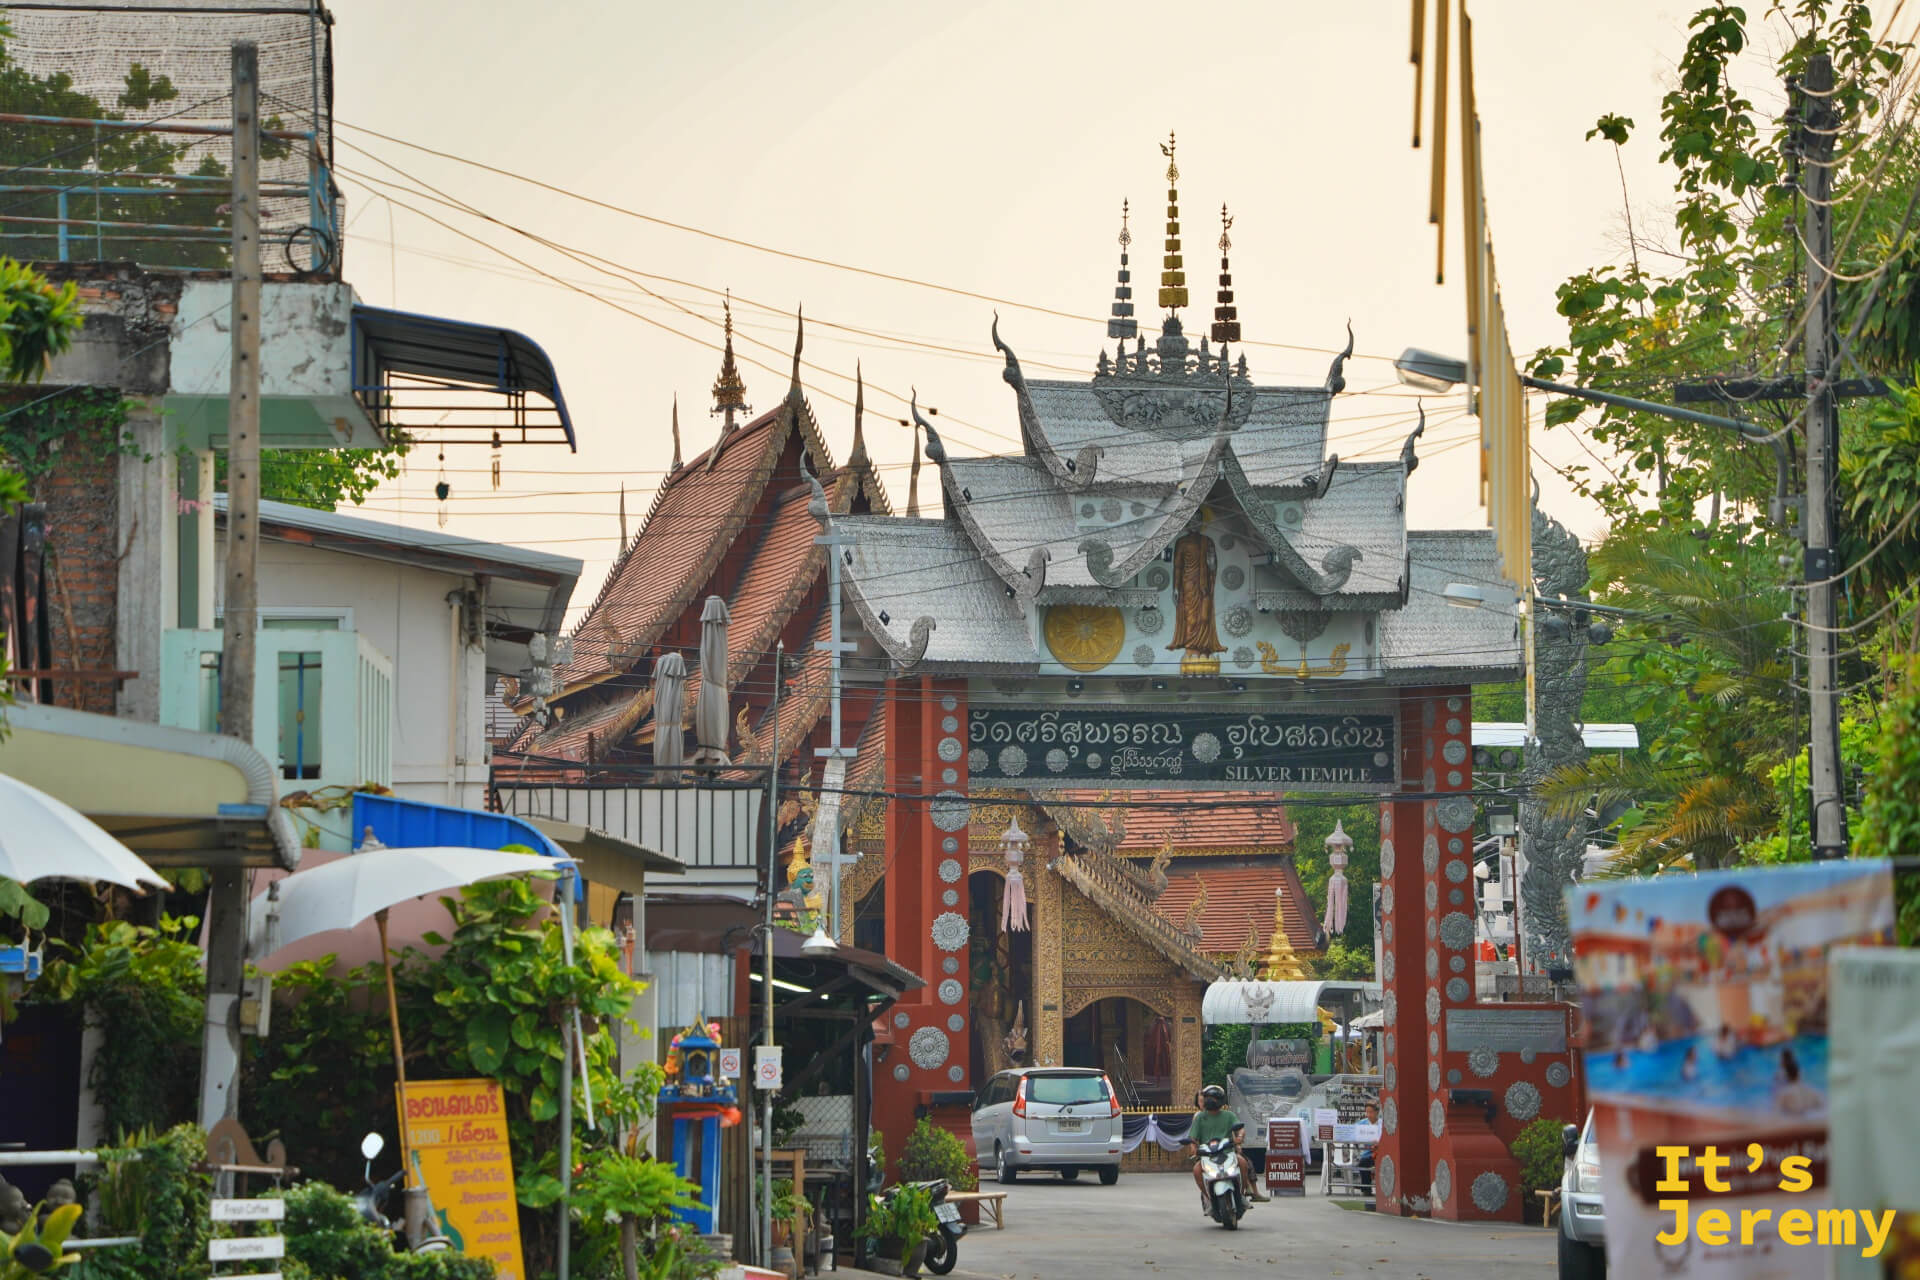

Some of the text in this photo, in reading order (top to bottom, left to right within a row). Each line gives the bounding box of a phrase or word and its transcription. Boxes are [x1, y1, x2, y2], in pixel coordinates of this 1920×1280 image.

[969, 711, 1183, 758] วัดศรีสุพรรณ
[1225, 714, 1385, 760] อุโบสถเงิน
[1225, 766, 1372, 782] SILVER TEMPLE
[407, 1083, 499, 1119] สอนดนตรี
[1268, 1171, 1301, 1181] ENTRANCE
